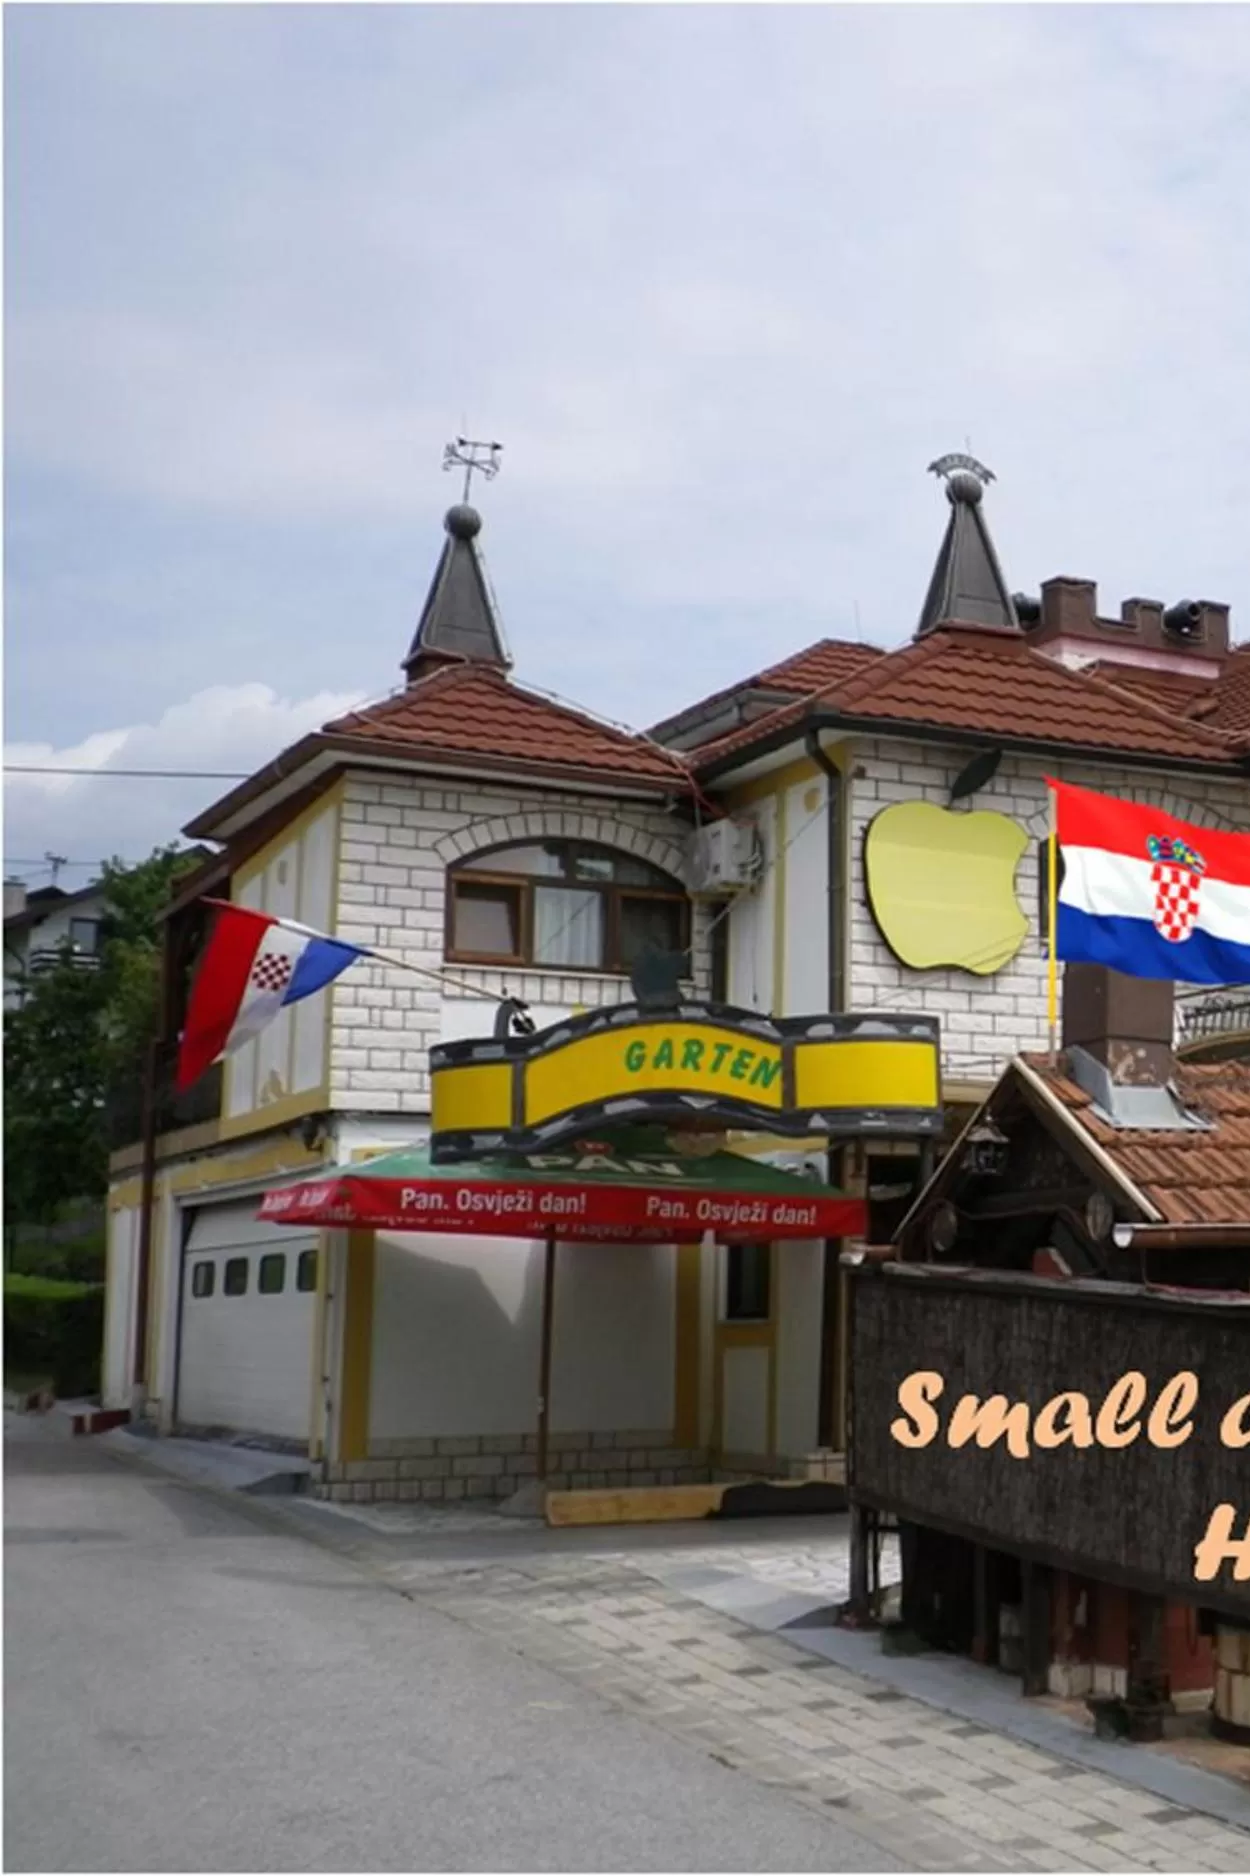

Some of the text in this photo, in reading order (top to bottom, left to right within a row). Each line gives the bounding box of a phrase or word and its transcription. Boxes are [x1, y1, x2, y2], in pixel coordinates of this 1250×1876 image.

[625, 1038, 782, 1089] GARTEN
[526, 1154, 684, 1177] PAN
[400, 1187, 587, 1216] Pan. Osvježi dan!
[646, 1196, 817, 1226] Pan. Osvježi dan!
